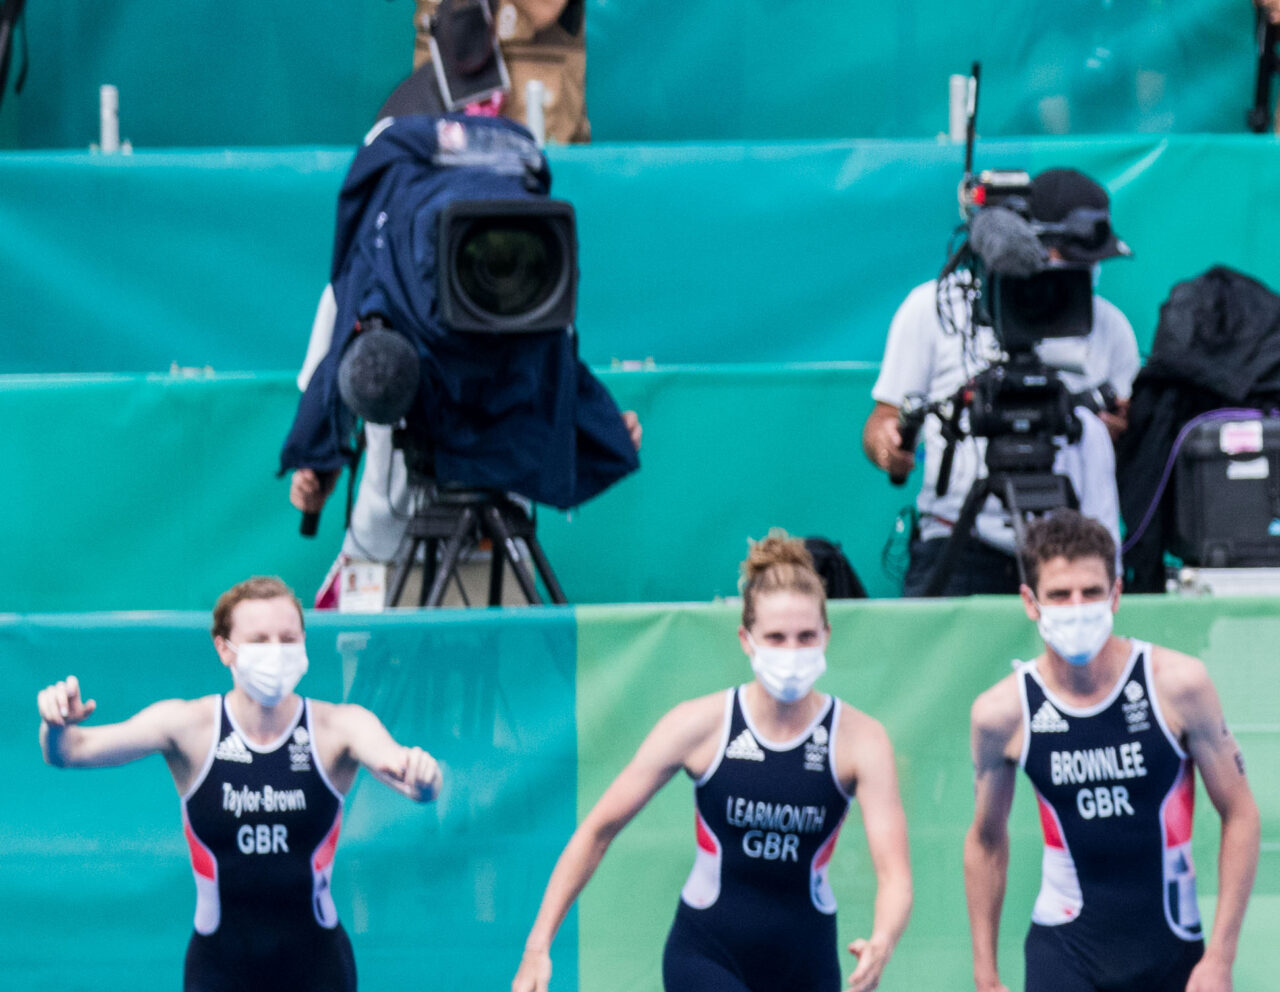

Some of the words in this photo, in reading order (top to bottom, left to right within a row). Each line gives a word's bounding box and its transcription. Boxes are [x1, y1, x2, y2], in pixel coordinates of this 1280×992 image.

[1050, 741, 1148, 786] BROWNLEE
[222, 782, 307, 818] Taylor-Brown
[726, 795, 827, 833] LEARMONTH
[1077, 785, 1135, 820] GBR
[237, 824, 289, 854] GBR
[742, 829, 800, 863] GBR
